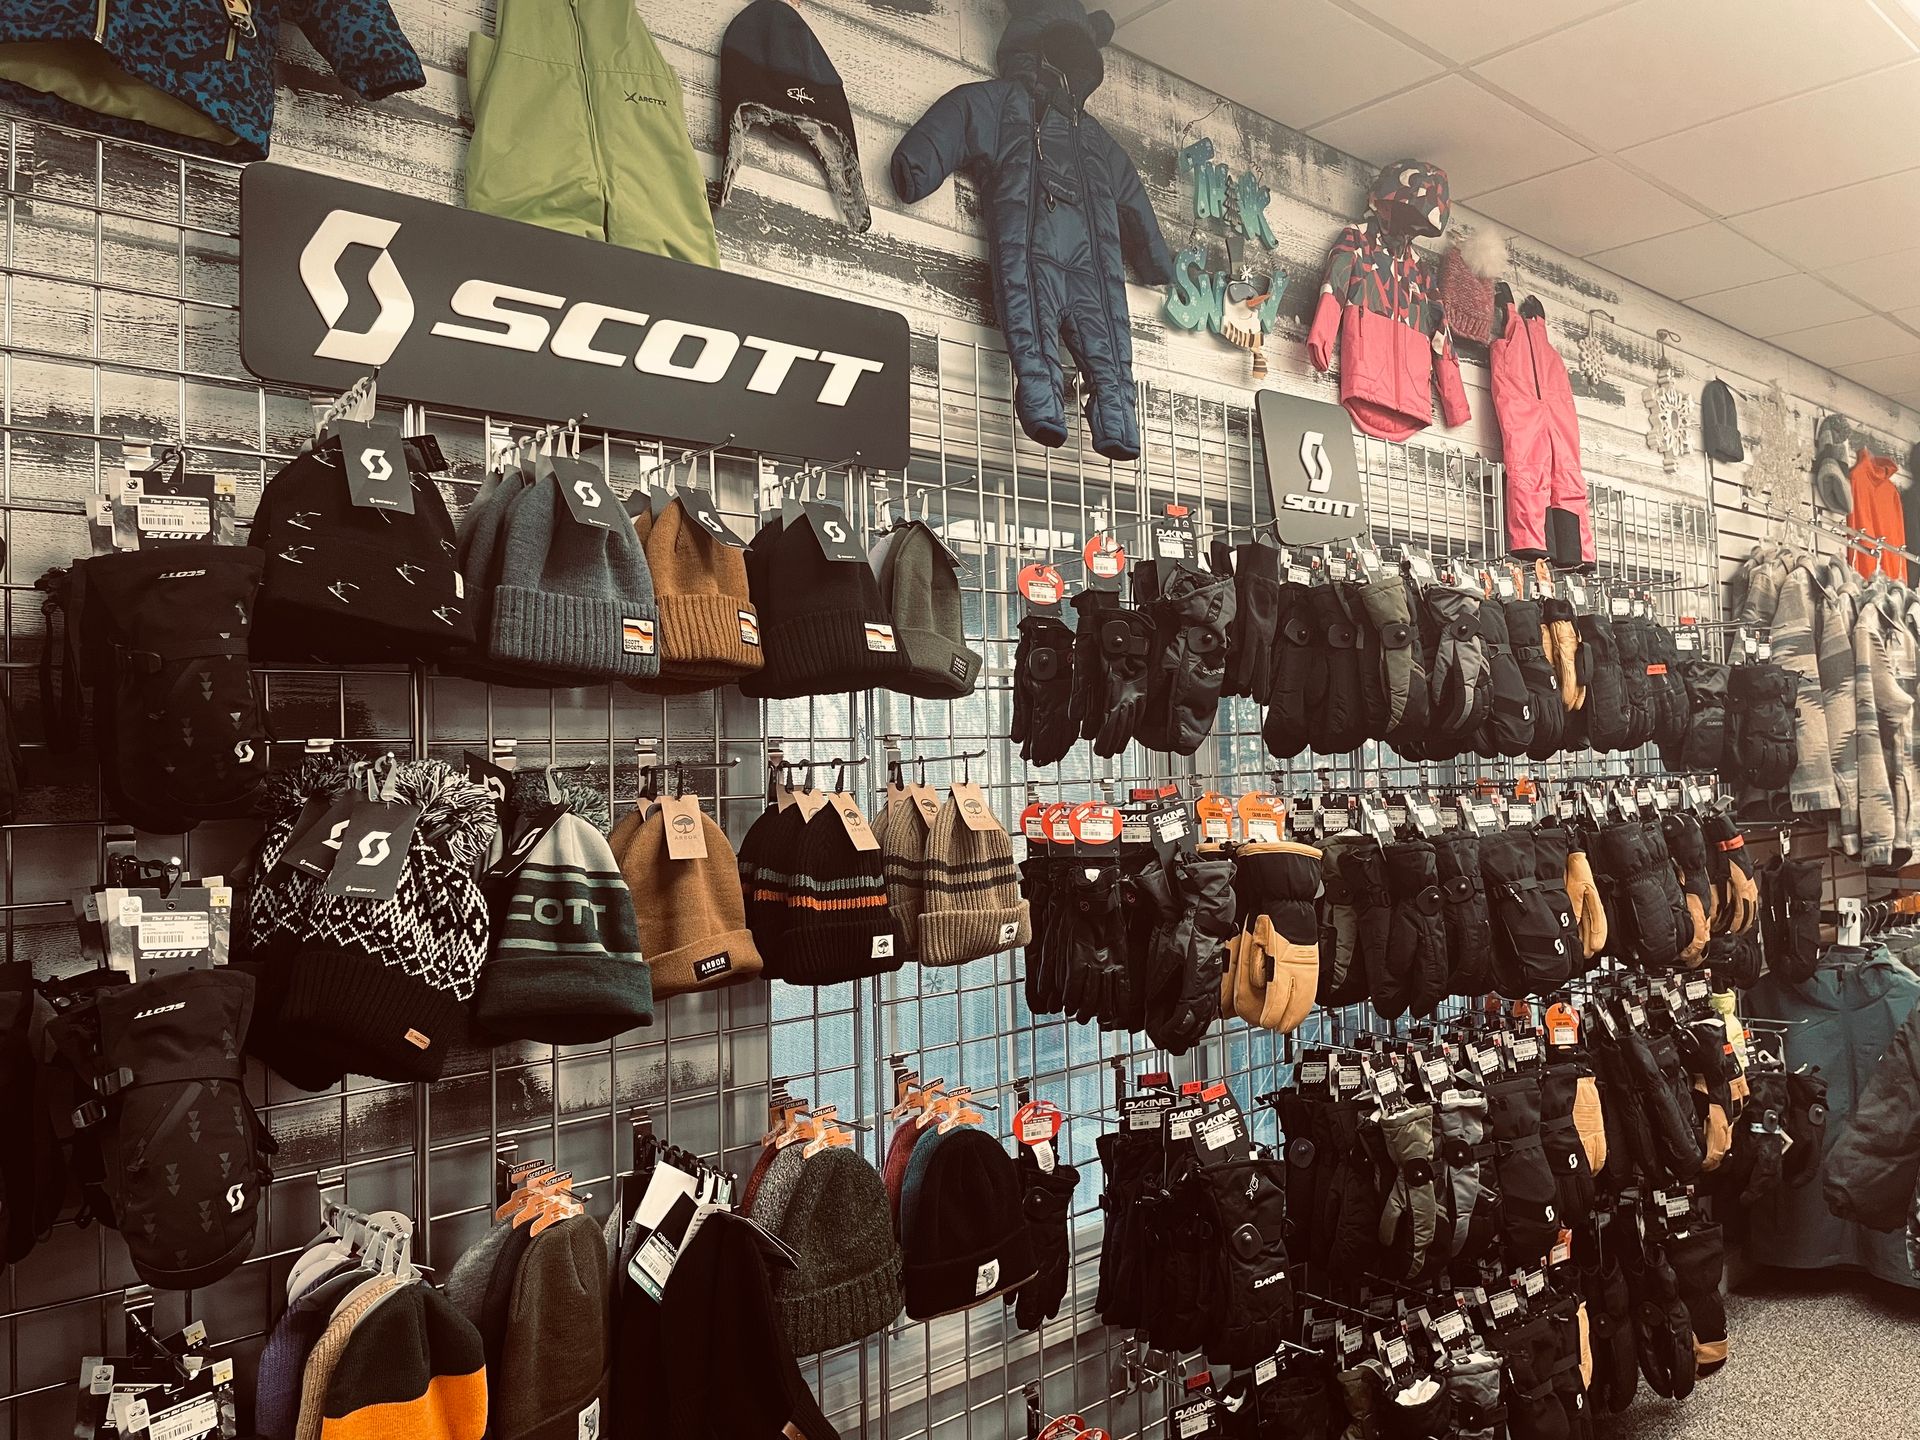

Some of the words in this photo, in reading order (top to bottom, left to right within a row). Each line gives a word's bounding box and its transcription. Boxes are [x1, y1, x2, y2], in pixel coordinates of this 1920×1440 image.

[638, 95, 667, 106] ARCTIX
[430, 279, 884, 407] SCOTT
[1281, 492, 1360, 518] SCOTT
[144, 531, 207, 540] SCOTT
[1156, 528, 1193, 540] DAKINE
[157, 569, 206, 580] SCOTT
[1152, 807, 1187, 825] DAKINE
[507, 893, 607, 931] COTT
[140, 949, 202, 960] SCOTT
[701, 956, 726, 972] ARBOR
[133, 1001, 186, 1019] SCOTT
[1482, 1066, 1498, 1075] SCOTT
[922, 1078, 943, 1092] SCREAMER
[949, 1088, 971, 1098] SCREAMER
[1124, 1097, 1172, 1110] DAKINE
[812, 1106, 836, 1118] SCREAMER
[1169, 1107, 1203, 1121] DAKINE
[1195, 1108, 1239, 1132] DAKINE
[512, 1160, 542, 1174] SCREAMER
[527, 1165, 553, 1179] SCREAMER
[546, 1171, 570, 1185] SCREAMER
[656, 1231, 679, 1256] OBERM
[630, 1266, 652, 1289] MERINO
[1253, 1271, 1286, 1289] DAKINE
[1174, 1400, 1217, 1420] DAKINE
